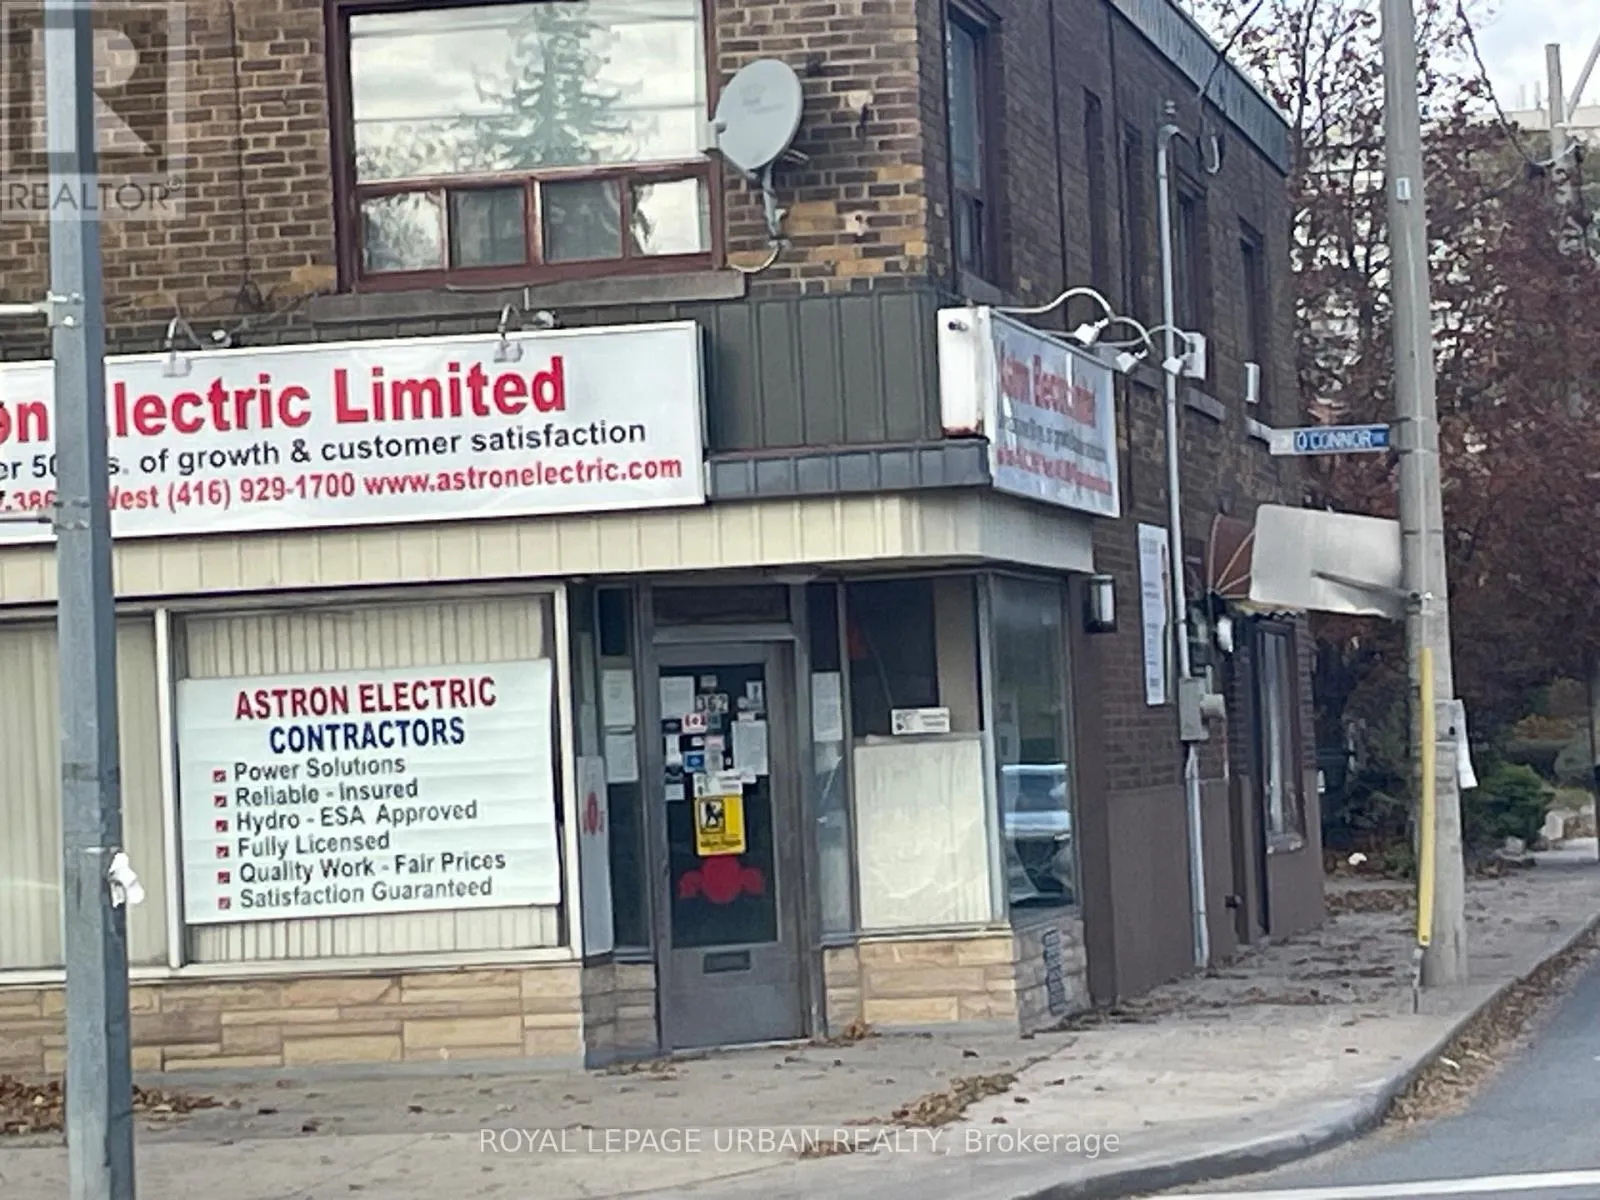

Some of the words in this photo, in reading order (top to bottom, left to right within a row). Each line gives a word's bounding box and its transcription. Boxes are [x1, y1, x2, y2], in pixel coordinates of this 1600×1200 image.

[114, 372, 312, 438] lectric
[334, 355, 566, 424] Limited
[140, 447, 169, 474] of
[178, 440, 279, 477] growth
[290, 438, 312, 463] &
[321, 434, 461, 462] customer
[471, 420, 647, 452] satisfaction
[168, 478, 231, 514] (416)
[240, 472, 355, 503] 929-1700
[363, 457, 683, 495] www.astronelectric.com
[235, 685, 350, 720] ASTRON
[360, 676, 497, 713] ELECTRIC
[269, 716, 466, 754] CONTRACTORS
[234, 761, 299, 782] Power
[306, 756, 406, 779] Solutions
[236, 784, 319, 807] Reliable
[340, 779, 418, 801] Insured
[236, 811, 300, 835] Hydro
[320, 806, 365, 828] ESA
[376, 800, 478, 829] Approved
[237, 834, 288, 860] Fully
[295, 831, 390, 855] Licensed
[239, 859, 314, 885] Quality
[322, 857, 375, 880] Work
[395, 854, 435, 876] Fair
[441, 851, 506, 873] Prices
[240, 886, 364, 909] Satisfaction
[371, 876, 493, 901] Guaranteed
